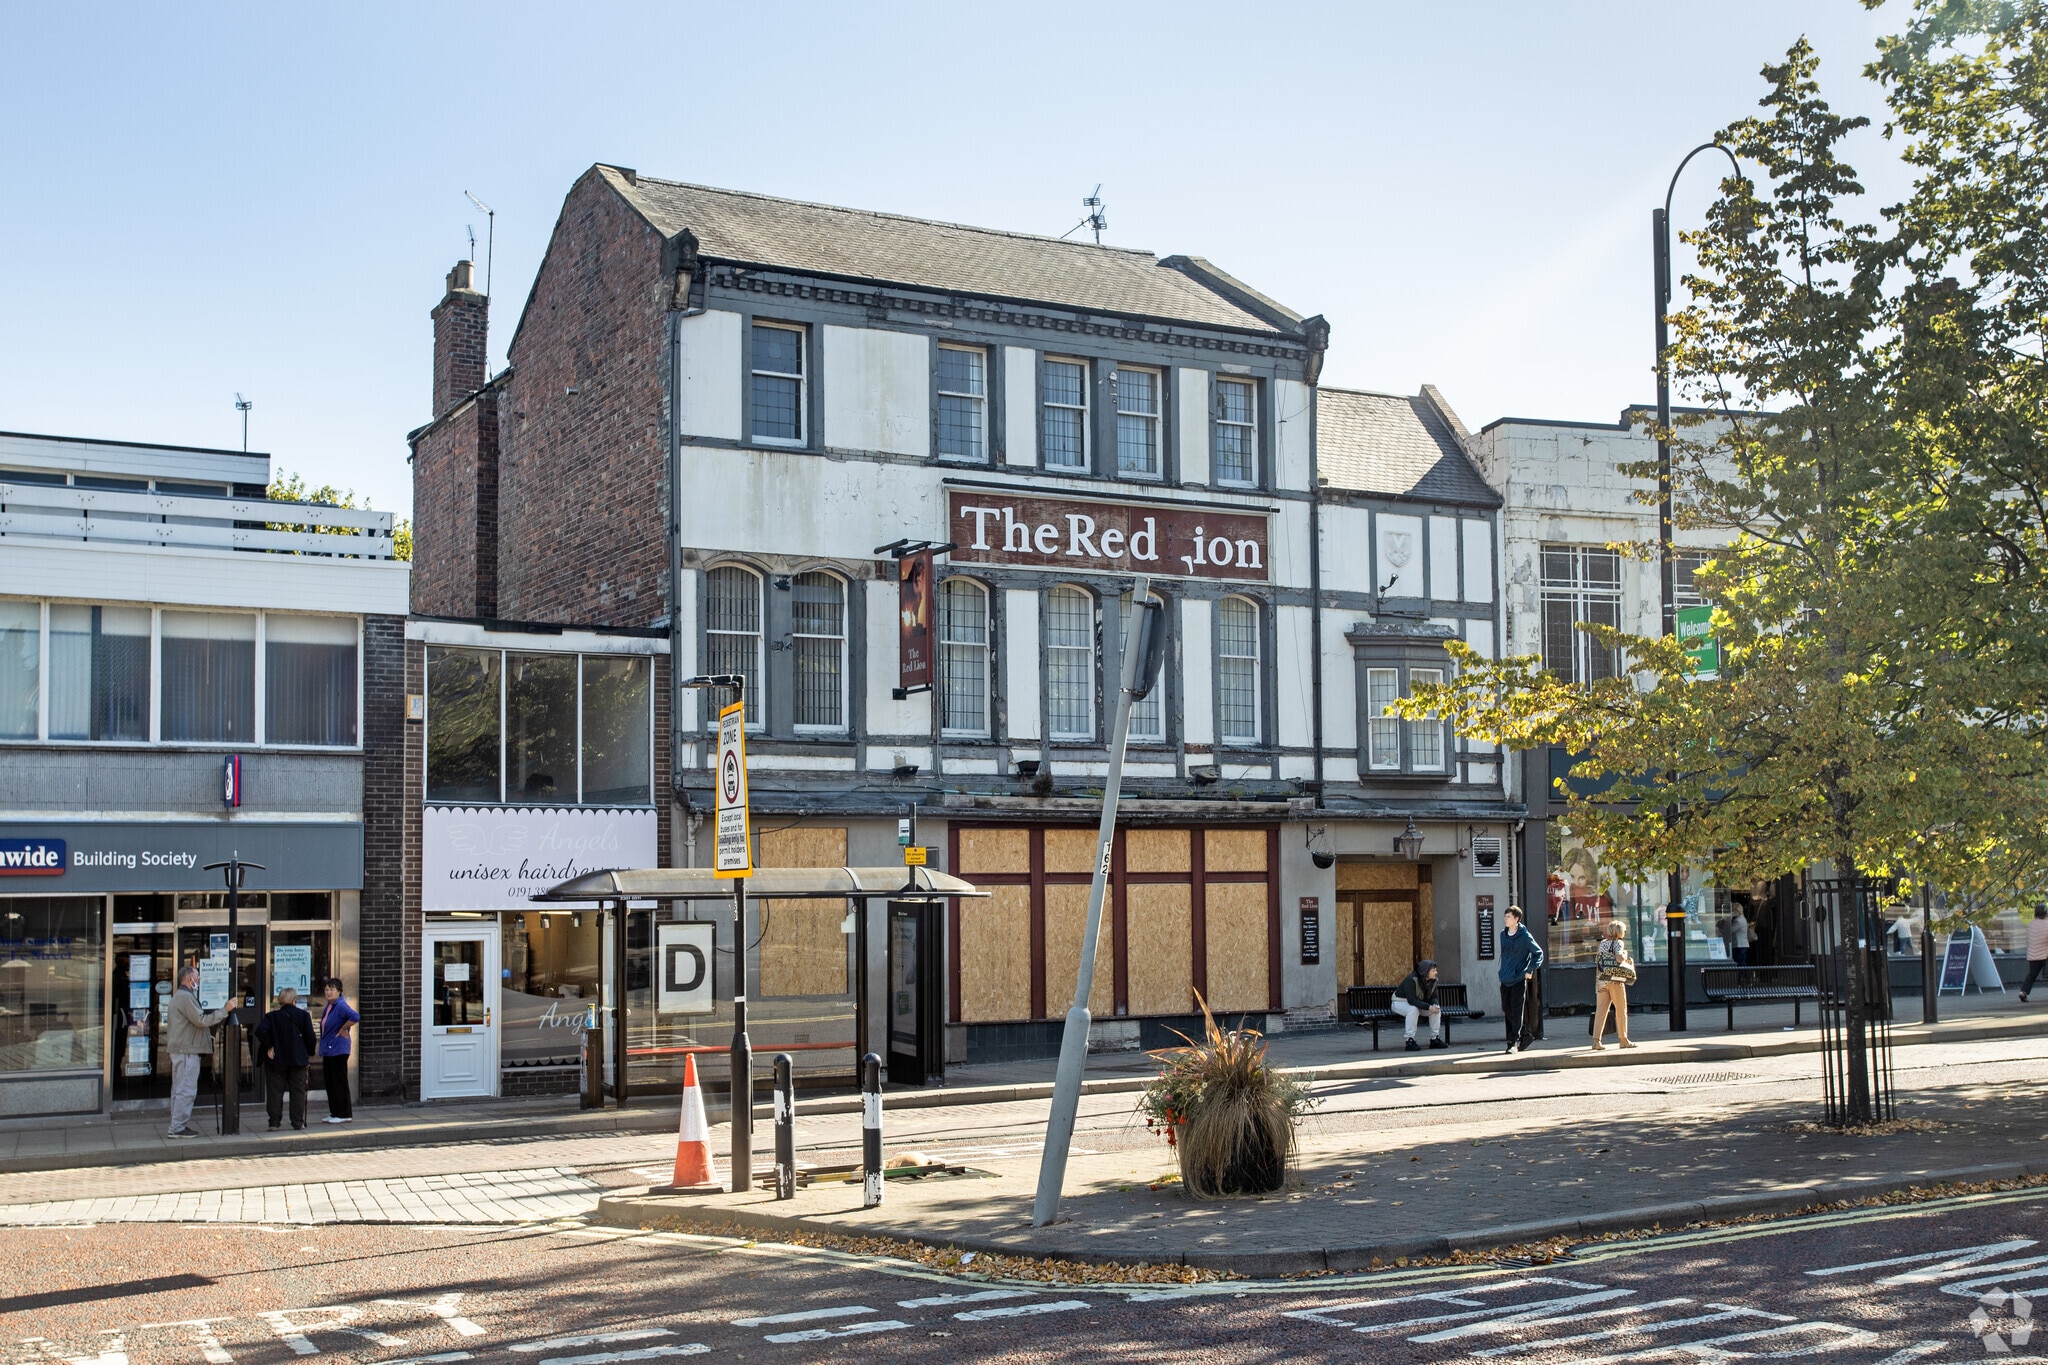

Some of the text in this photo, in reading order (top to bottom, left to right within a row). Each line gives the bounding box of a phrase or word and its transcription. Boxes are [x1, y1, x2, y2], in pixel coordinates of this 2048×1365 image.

[960, 505, 1060, 555] The
[1064, 513, 1159, 561] Red
[907, 648, 920, 660] The
[902, 660, 926, 674] Red Lion
[723, 729, 737, 745] ZONE
[721, 811, 742, 823] Except local
[720, 825, 730, 834] buses
[538, 822, 621, 857] Angels
[718, 833, 745, 846] loading only to
[730, 845, 745, 854] holders
[73, 851, 136, 869] Building
[141, 851, 197, 868] Society
[723, 857, 741, 867] premises
[450, 863, 512, 880] unisex
